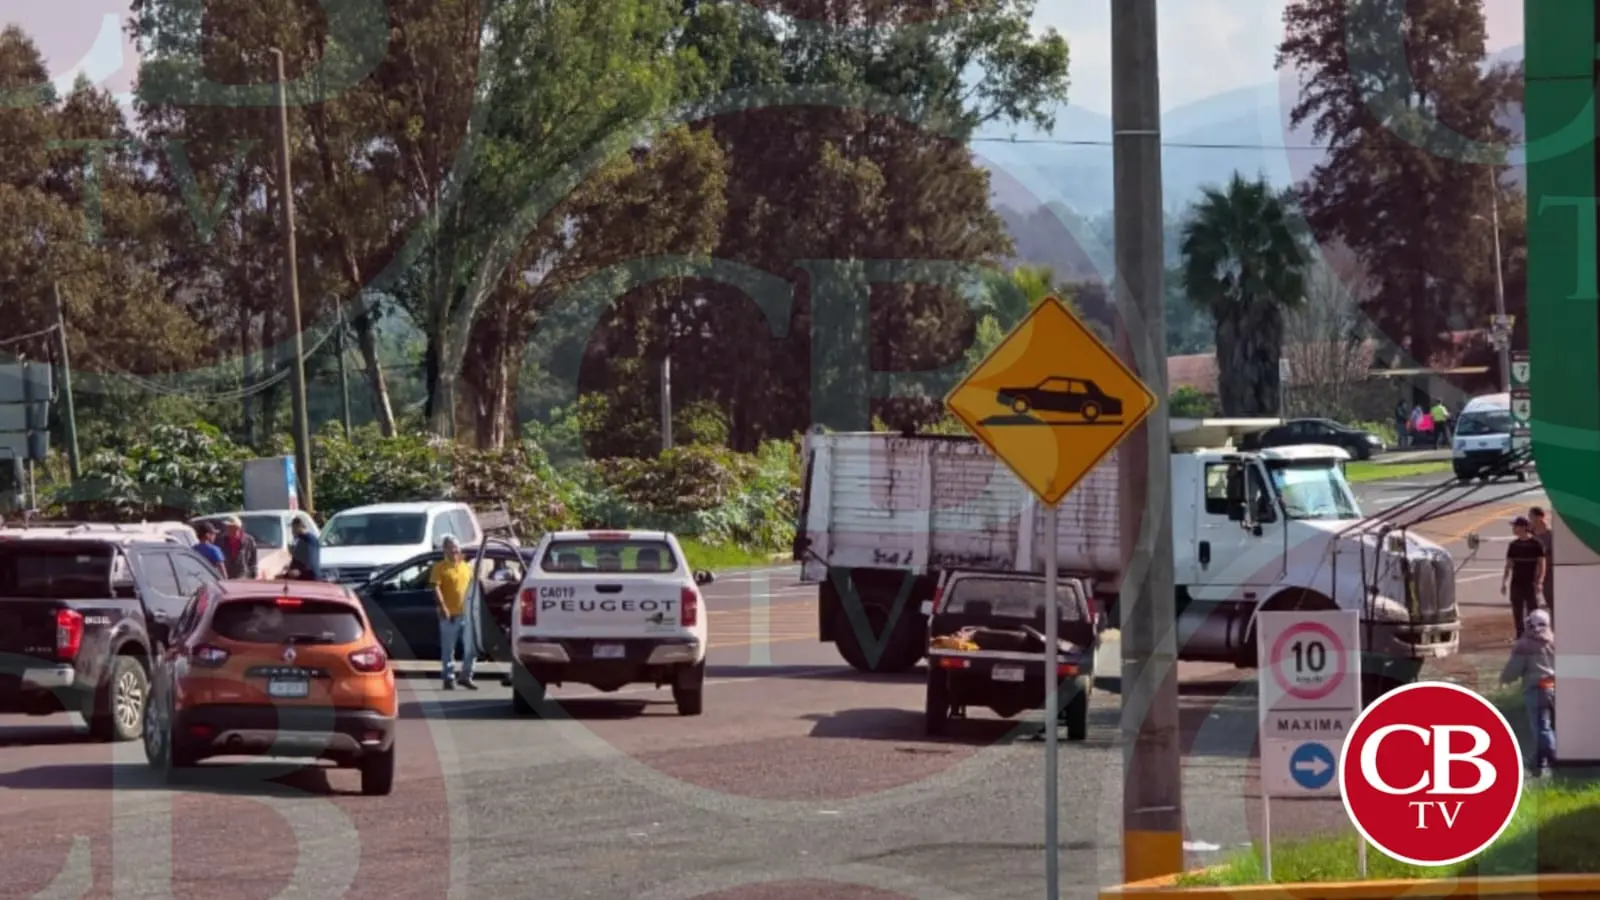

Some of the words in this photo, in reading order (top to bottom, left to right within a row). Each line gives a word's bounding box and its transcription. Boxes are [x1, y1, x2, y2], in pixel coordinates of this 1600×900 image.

[540, 586, 575, 598] CA019
[541, 600, 676, 612] PEUGEOT
[1291, 641, 1326, 672] 10
[1277, 719, 1343, 731] MAXIMA
